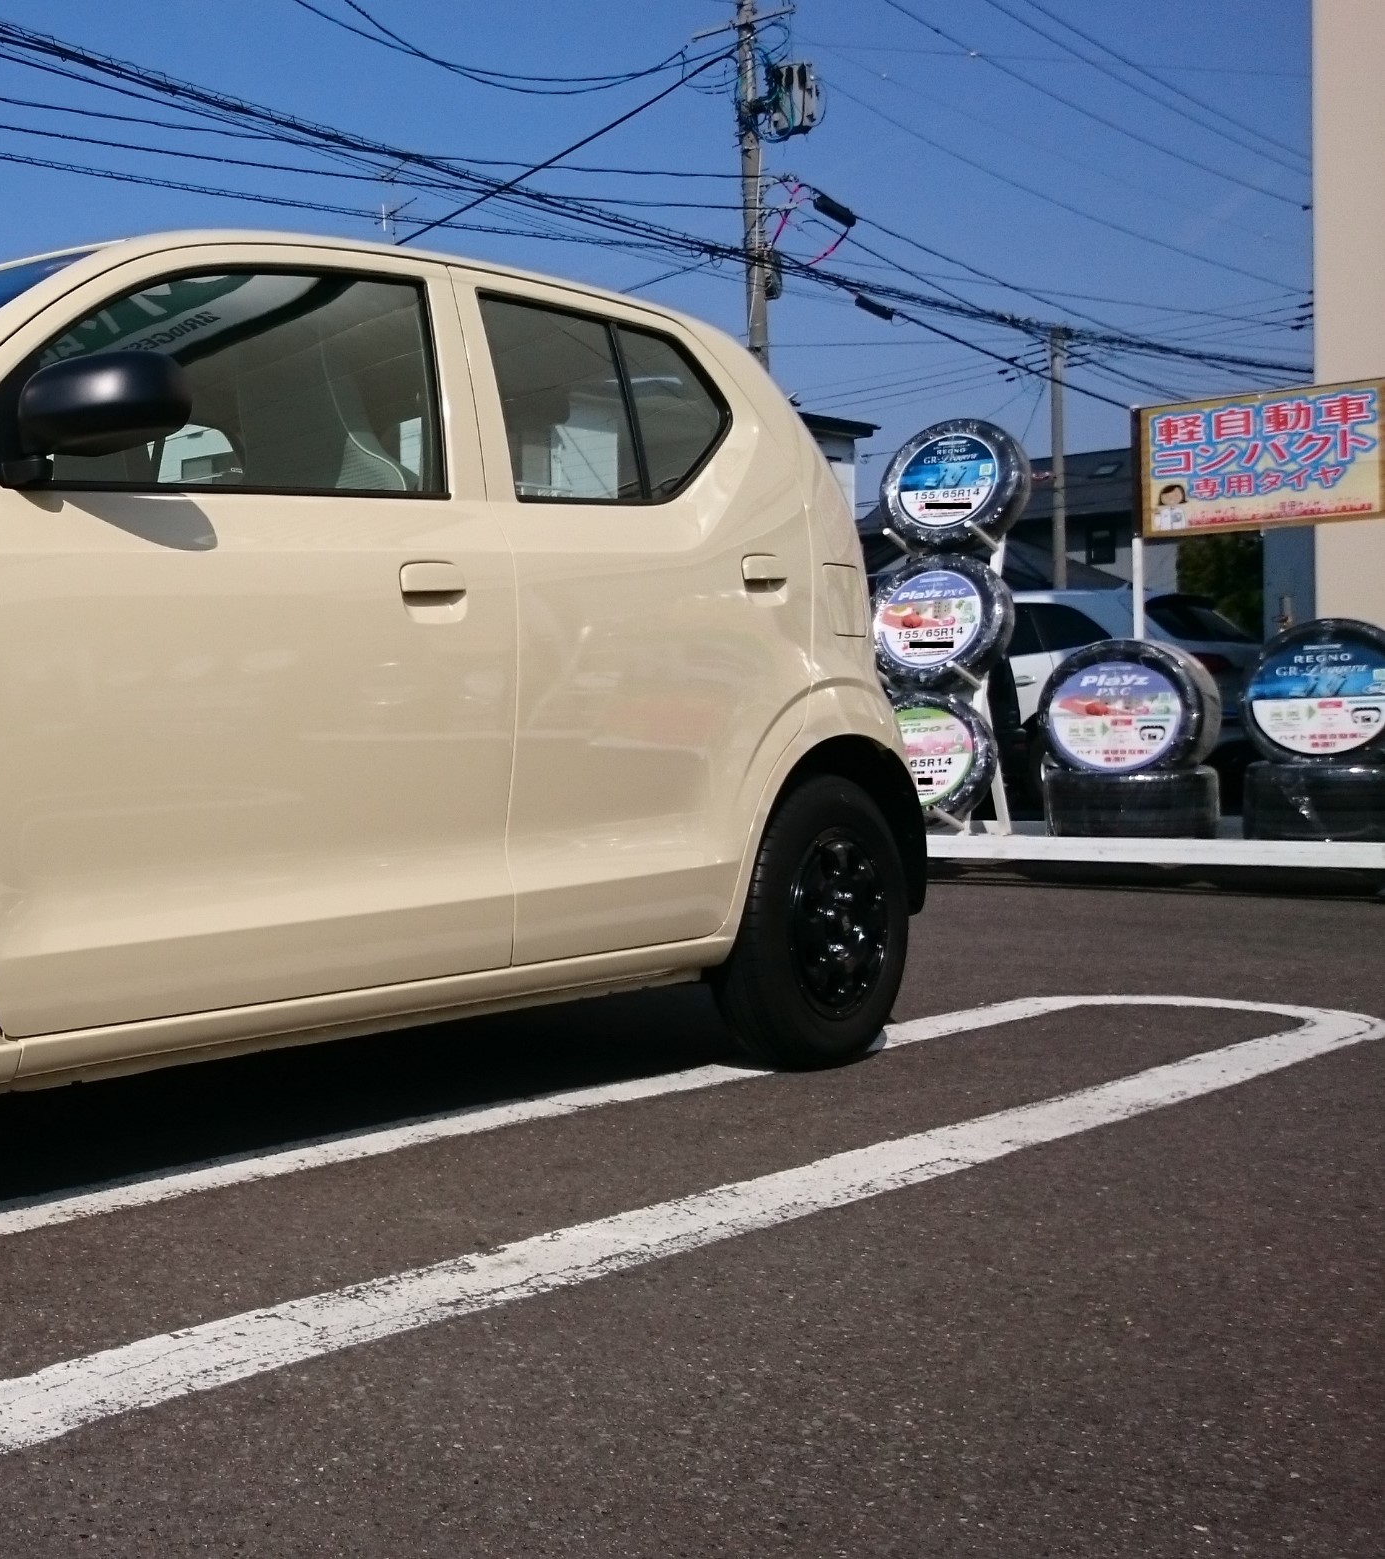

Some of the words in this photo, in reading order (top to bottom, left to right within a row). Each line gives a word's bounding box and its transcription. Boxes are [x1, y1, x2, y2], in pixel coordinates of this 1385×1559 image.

[1155, 393, 1372, 446] 軽自動車
[1155, 427, 1371, 476] コンパクト
[1192, 465, 1344, 497] 専用タイヤ
[914, 488, 980, 500] 155/65R14
[898, 588, 943, 601] Playz
[897, 626, 963, 640] 155/65R14
[1294, 653, 1352, 663] REGNO
[1080, 674, 1151, 687] Playz
